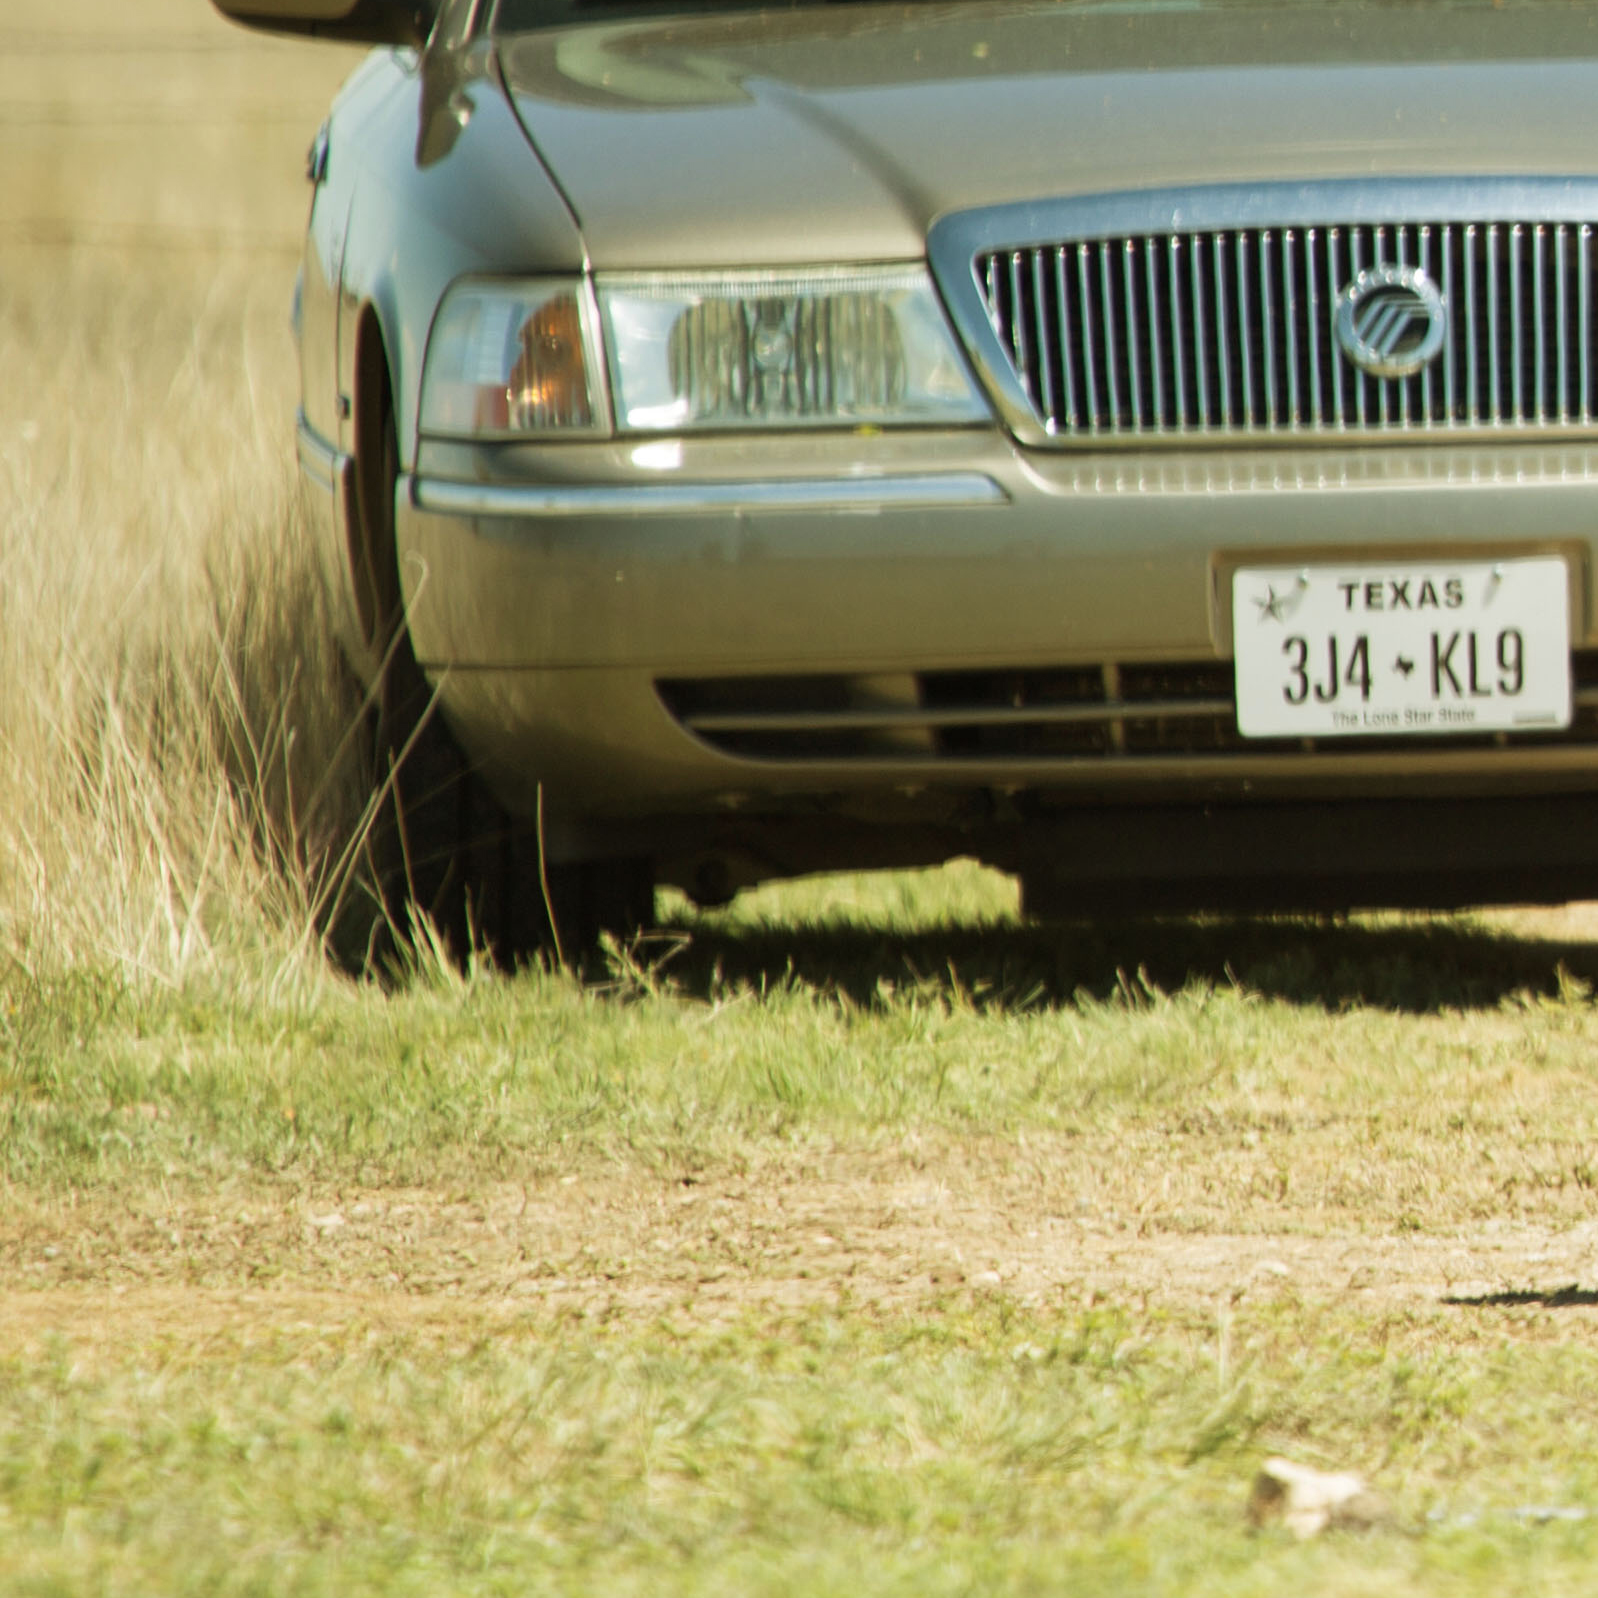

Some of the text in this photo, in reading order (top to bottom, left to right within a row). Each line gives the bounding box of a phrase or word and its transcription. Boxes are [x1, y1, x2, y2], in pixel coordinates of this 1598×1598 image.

[1338, 578, 1464, 611] TEXAS
[1281, 628, 1525, 704] 3J4 KL9
[1331, 706, 1476, 727] The Lone Star State
